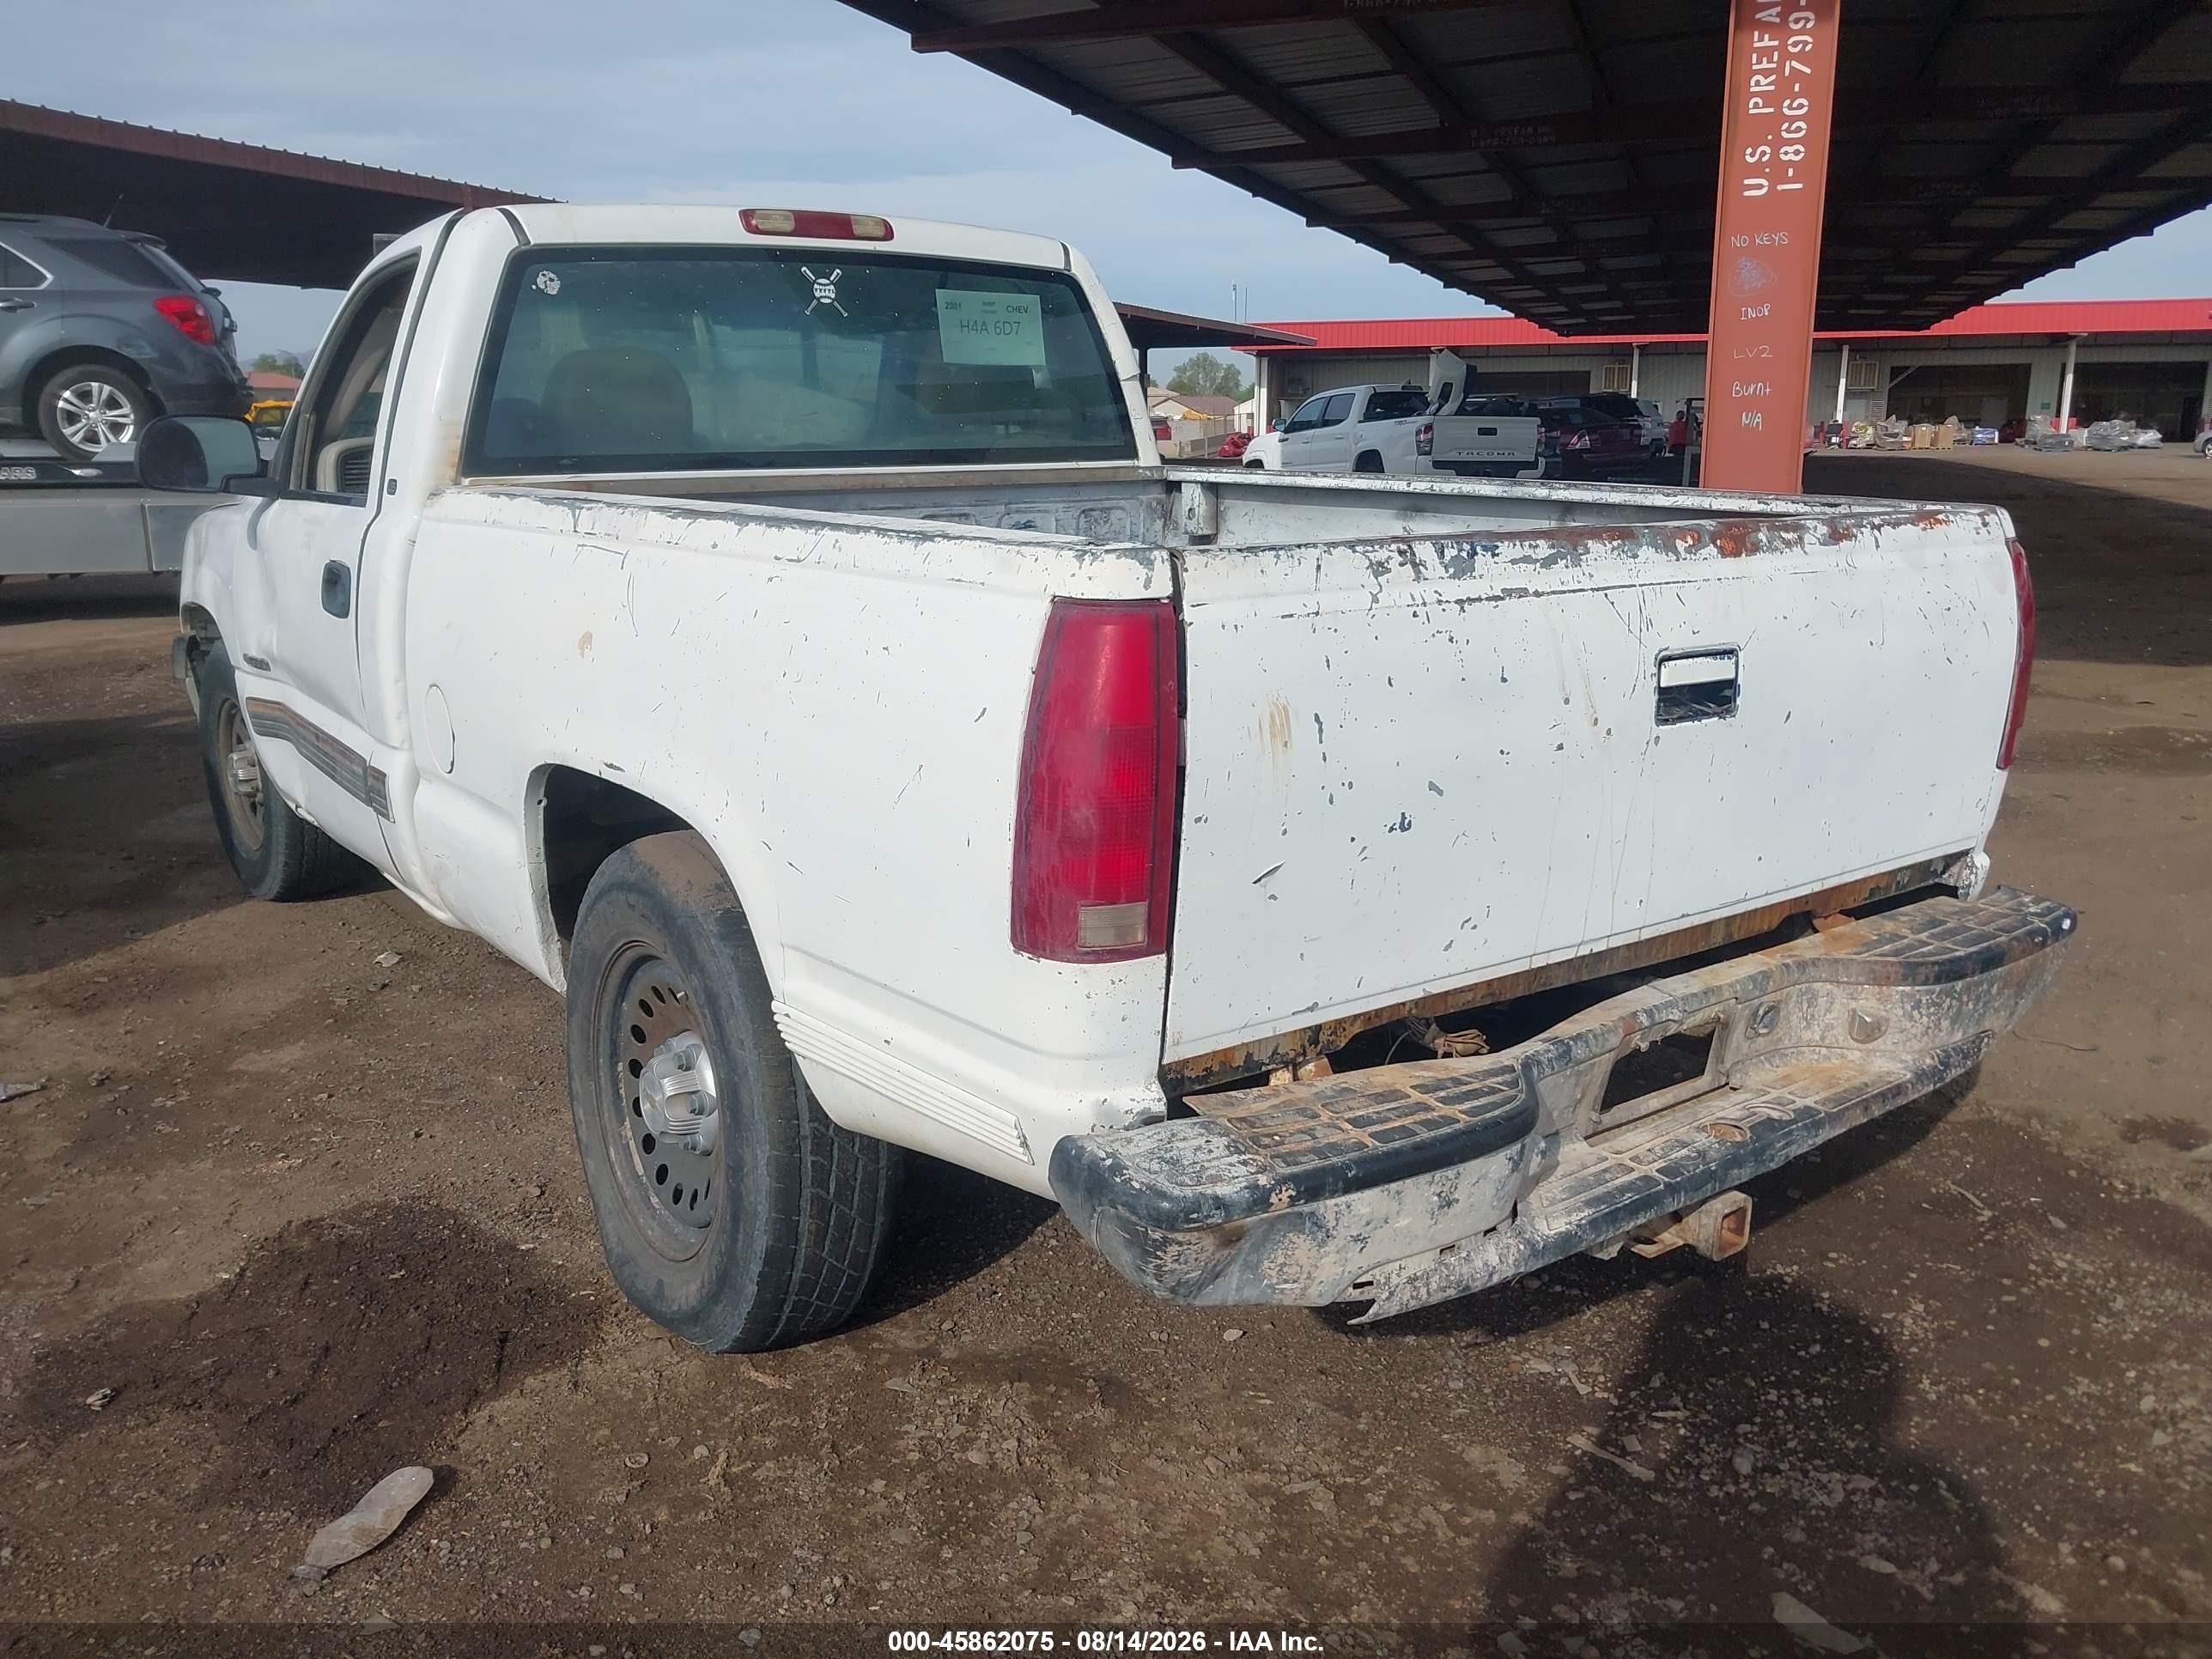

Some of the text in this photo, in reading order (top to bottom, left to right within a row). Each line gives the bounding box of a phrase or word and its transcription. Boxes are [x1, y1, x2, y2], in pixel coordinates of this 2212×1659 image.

[1742, 0, 1782, 197] U.S. PREFA
[1731, 232, 1789, 247] NO KEYS
[1006, 305, 1029, 314] CHEV
[1740, 303, 1771, 320] INOP
[960, 319, 1021, 336] H4A 6D7
[1734, 345, 1772, 359] LV2
[1741, 409, 1763, 430] N/A
